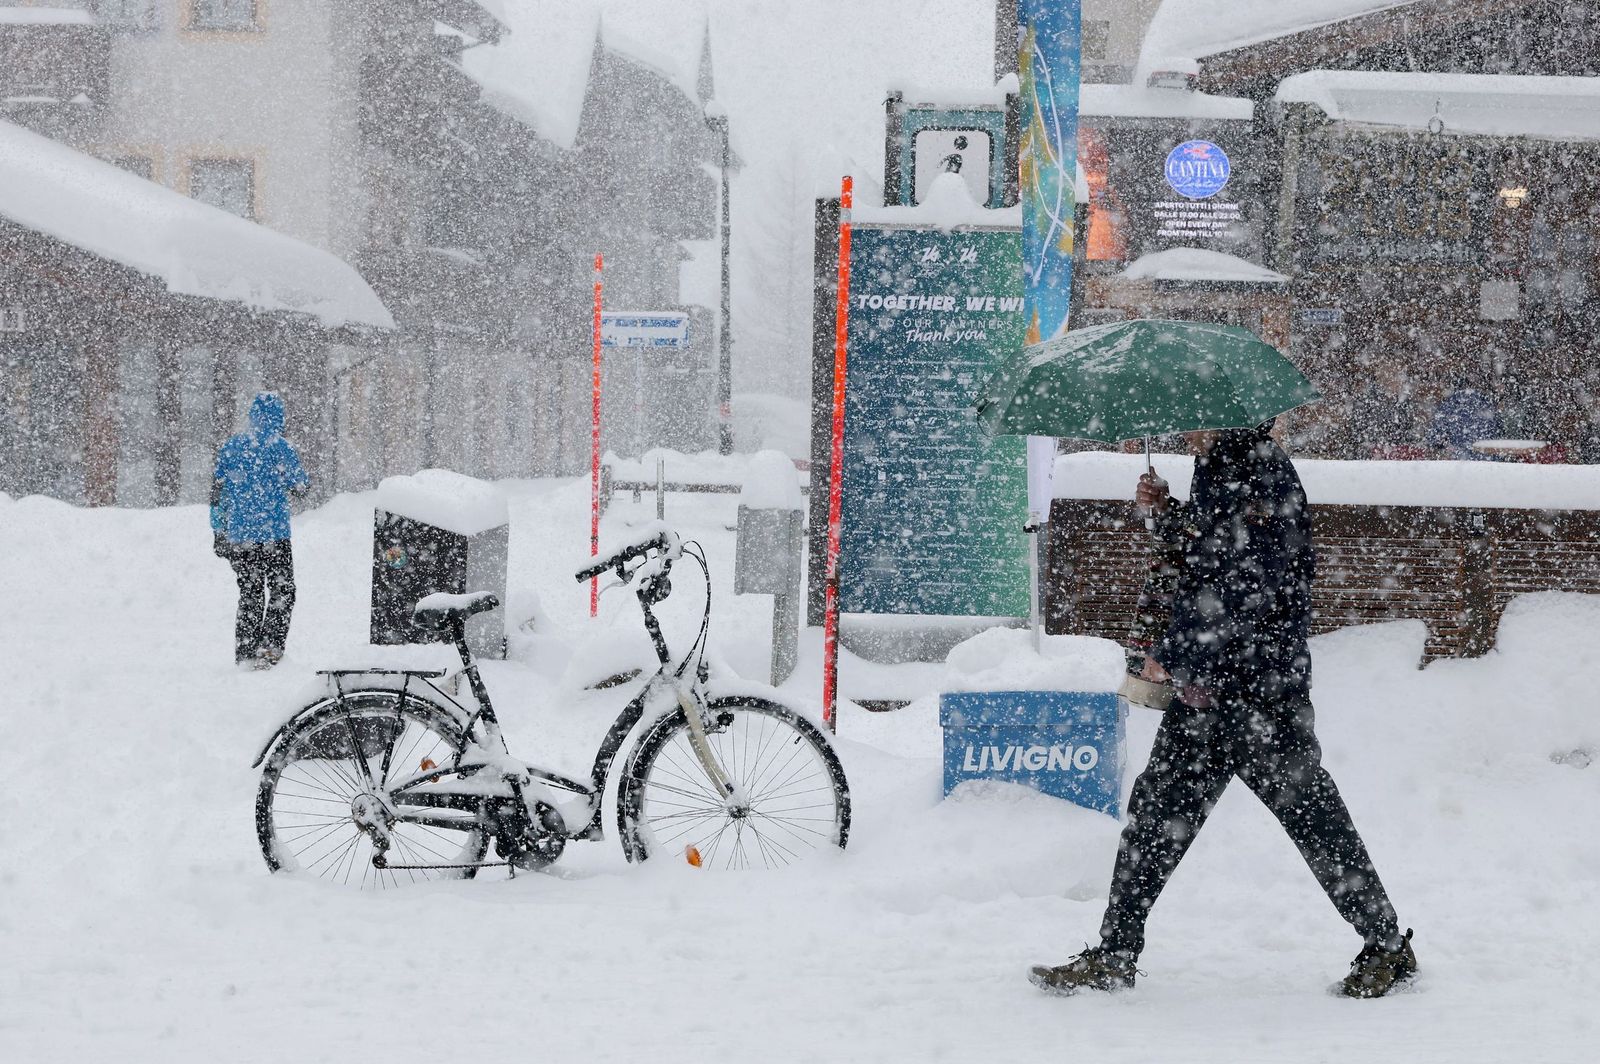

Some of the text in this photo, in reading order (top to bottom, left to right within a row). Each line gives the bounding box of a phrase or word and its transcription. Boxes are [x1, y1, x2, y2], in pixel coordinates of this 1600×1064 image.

[1169, 159, 1225, 178] CANTINA
[1165, 220, 1186, 228] OPEN
[1187, 220, 1211, 228] EVERY
[858, 294, 1023, 312] TOGETHER, WE WI
[878, 317, 1013, 329] TO OUR PARTNERS
[905, 327, 987, 345] Thank you
[963, 745, 1098, 771] LIVIGNO
